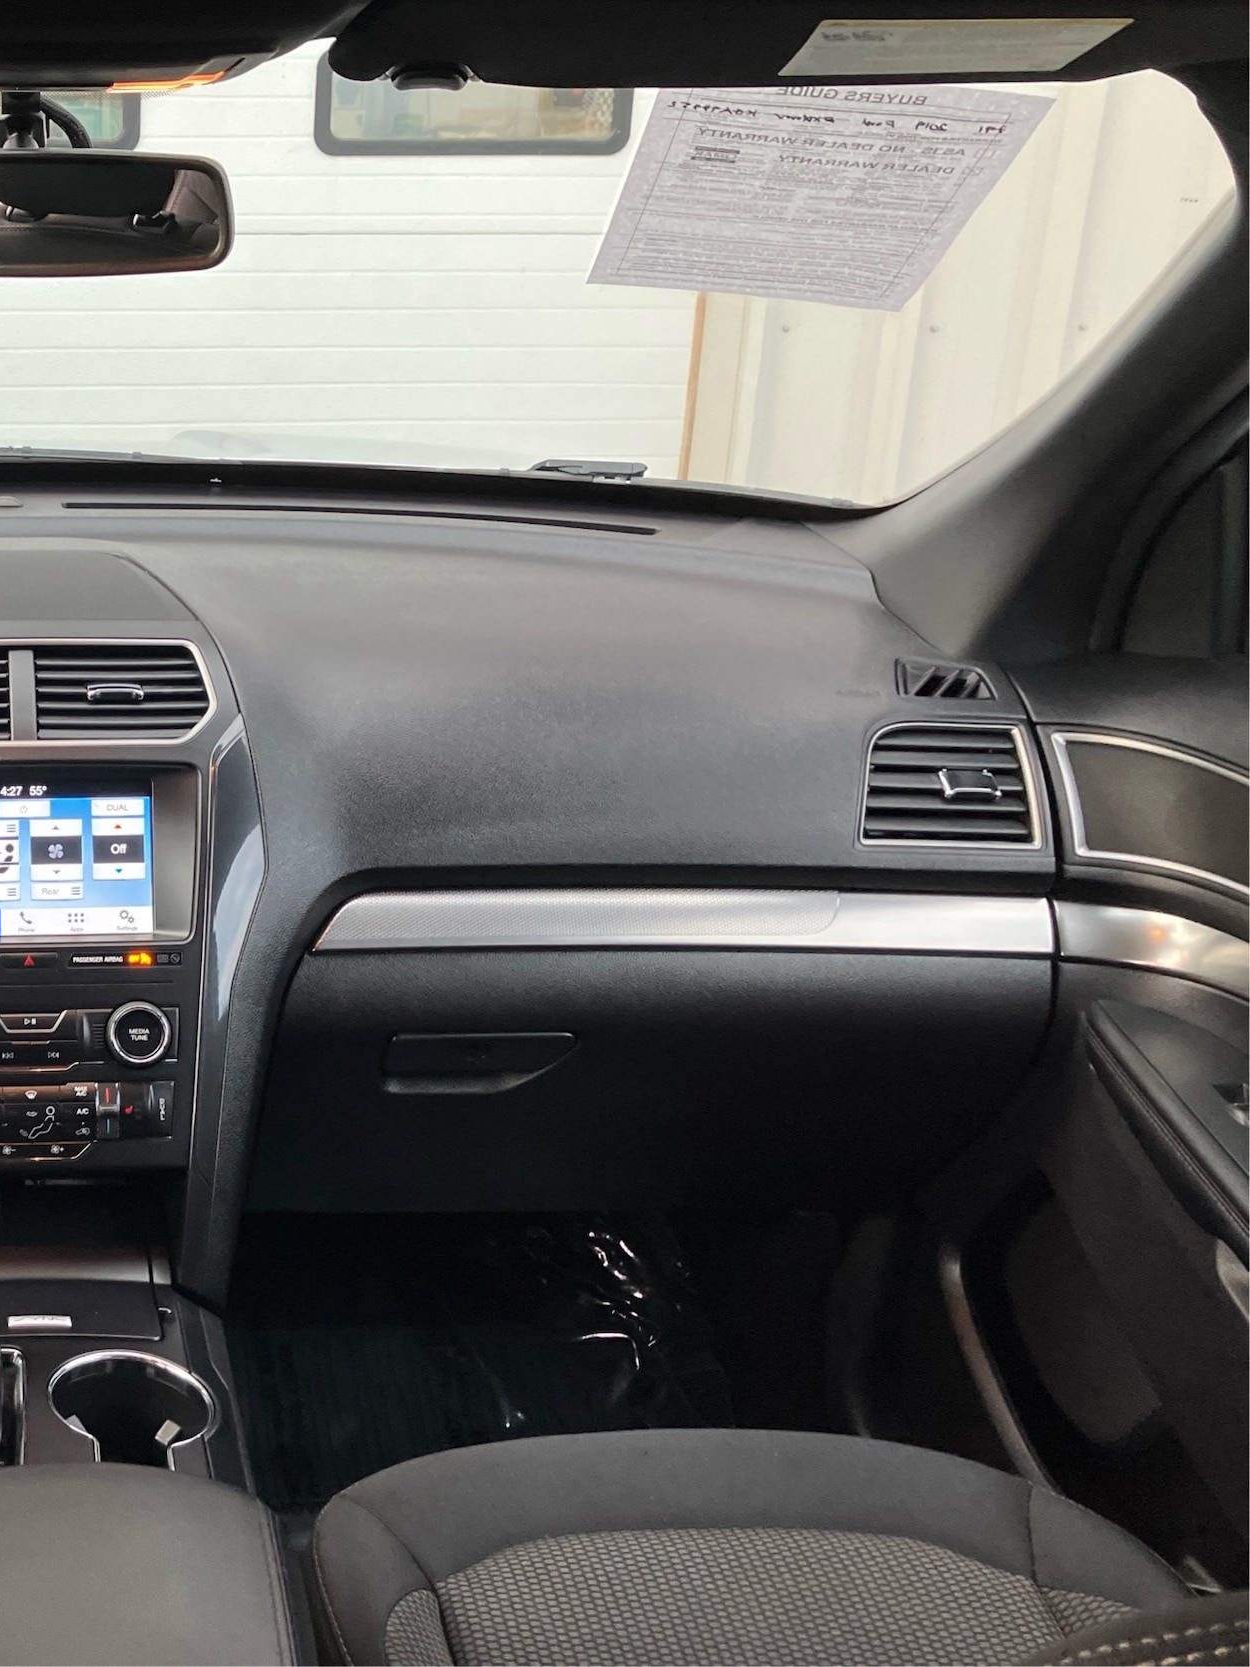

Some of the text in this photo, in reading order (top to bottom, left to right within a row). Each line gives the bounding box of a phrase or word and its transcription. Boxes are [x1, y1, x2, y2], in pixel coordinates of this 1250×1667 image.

[0, 786, 23, 797] 4:27
[107, 804, 129, 812] DUAL
[110, 843, 127, 854] Off
[104, 955, 124, 963] AIRBAG
[158, 1097, 166, 1121] DUAL
